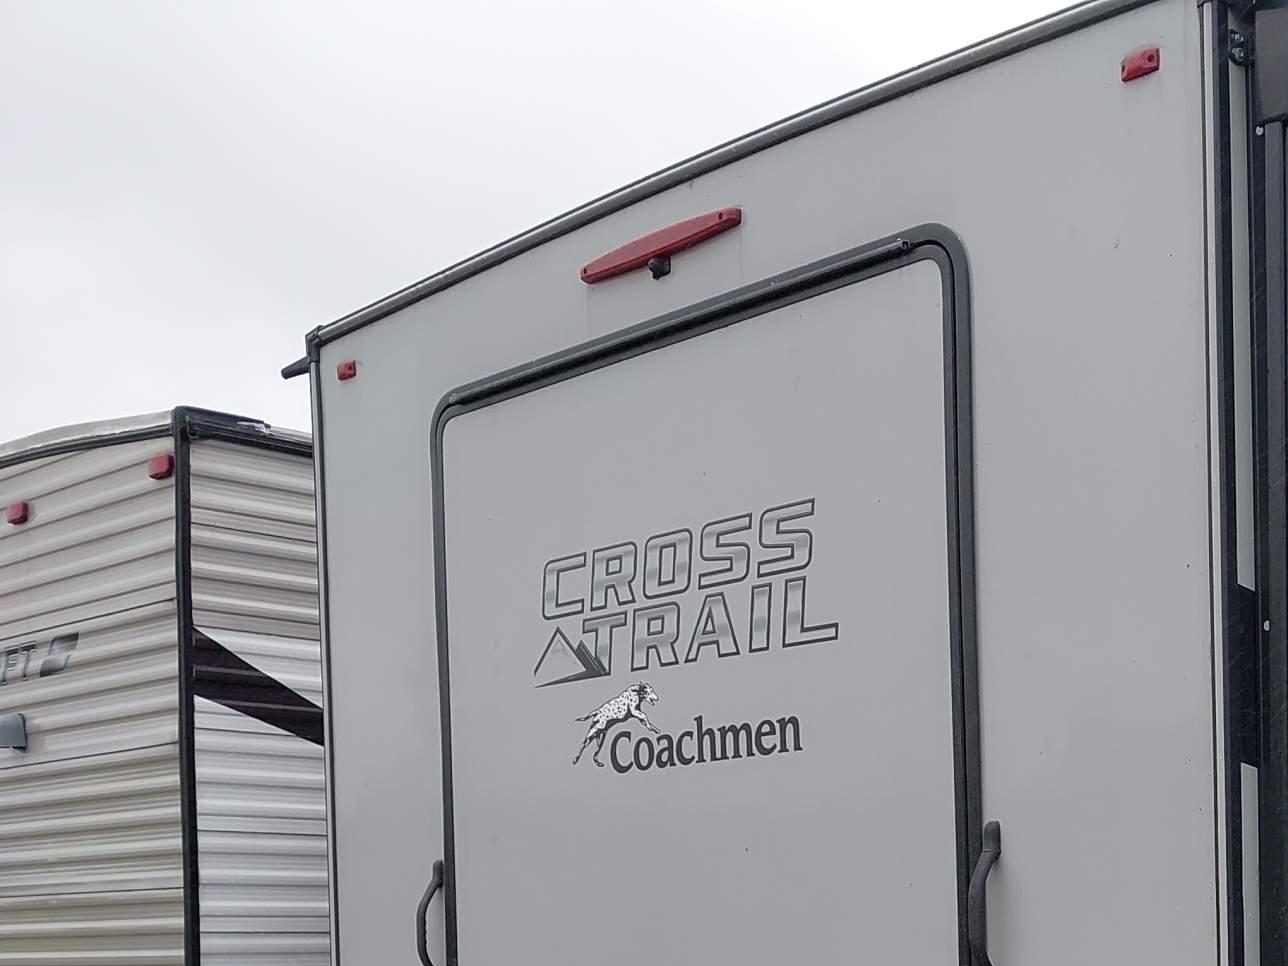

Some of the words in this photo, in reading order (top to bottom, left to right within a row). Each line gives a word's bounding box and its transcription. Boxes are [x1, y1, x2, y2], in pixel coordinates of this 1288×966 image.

[541, 498, 815, 620] CROSS
[582, 576, 839, 676] TRAIL
[610, 714, 803, 774] Coachmen
